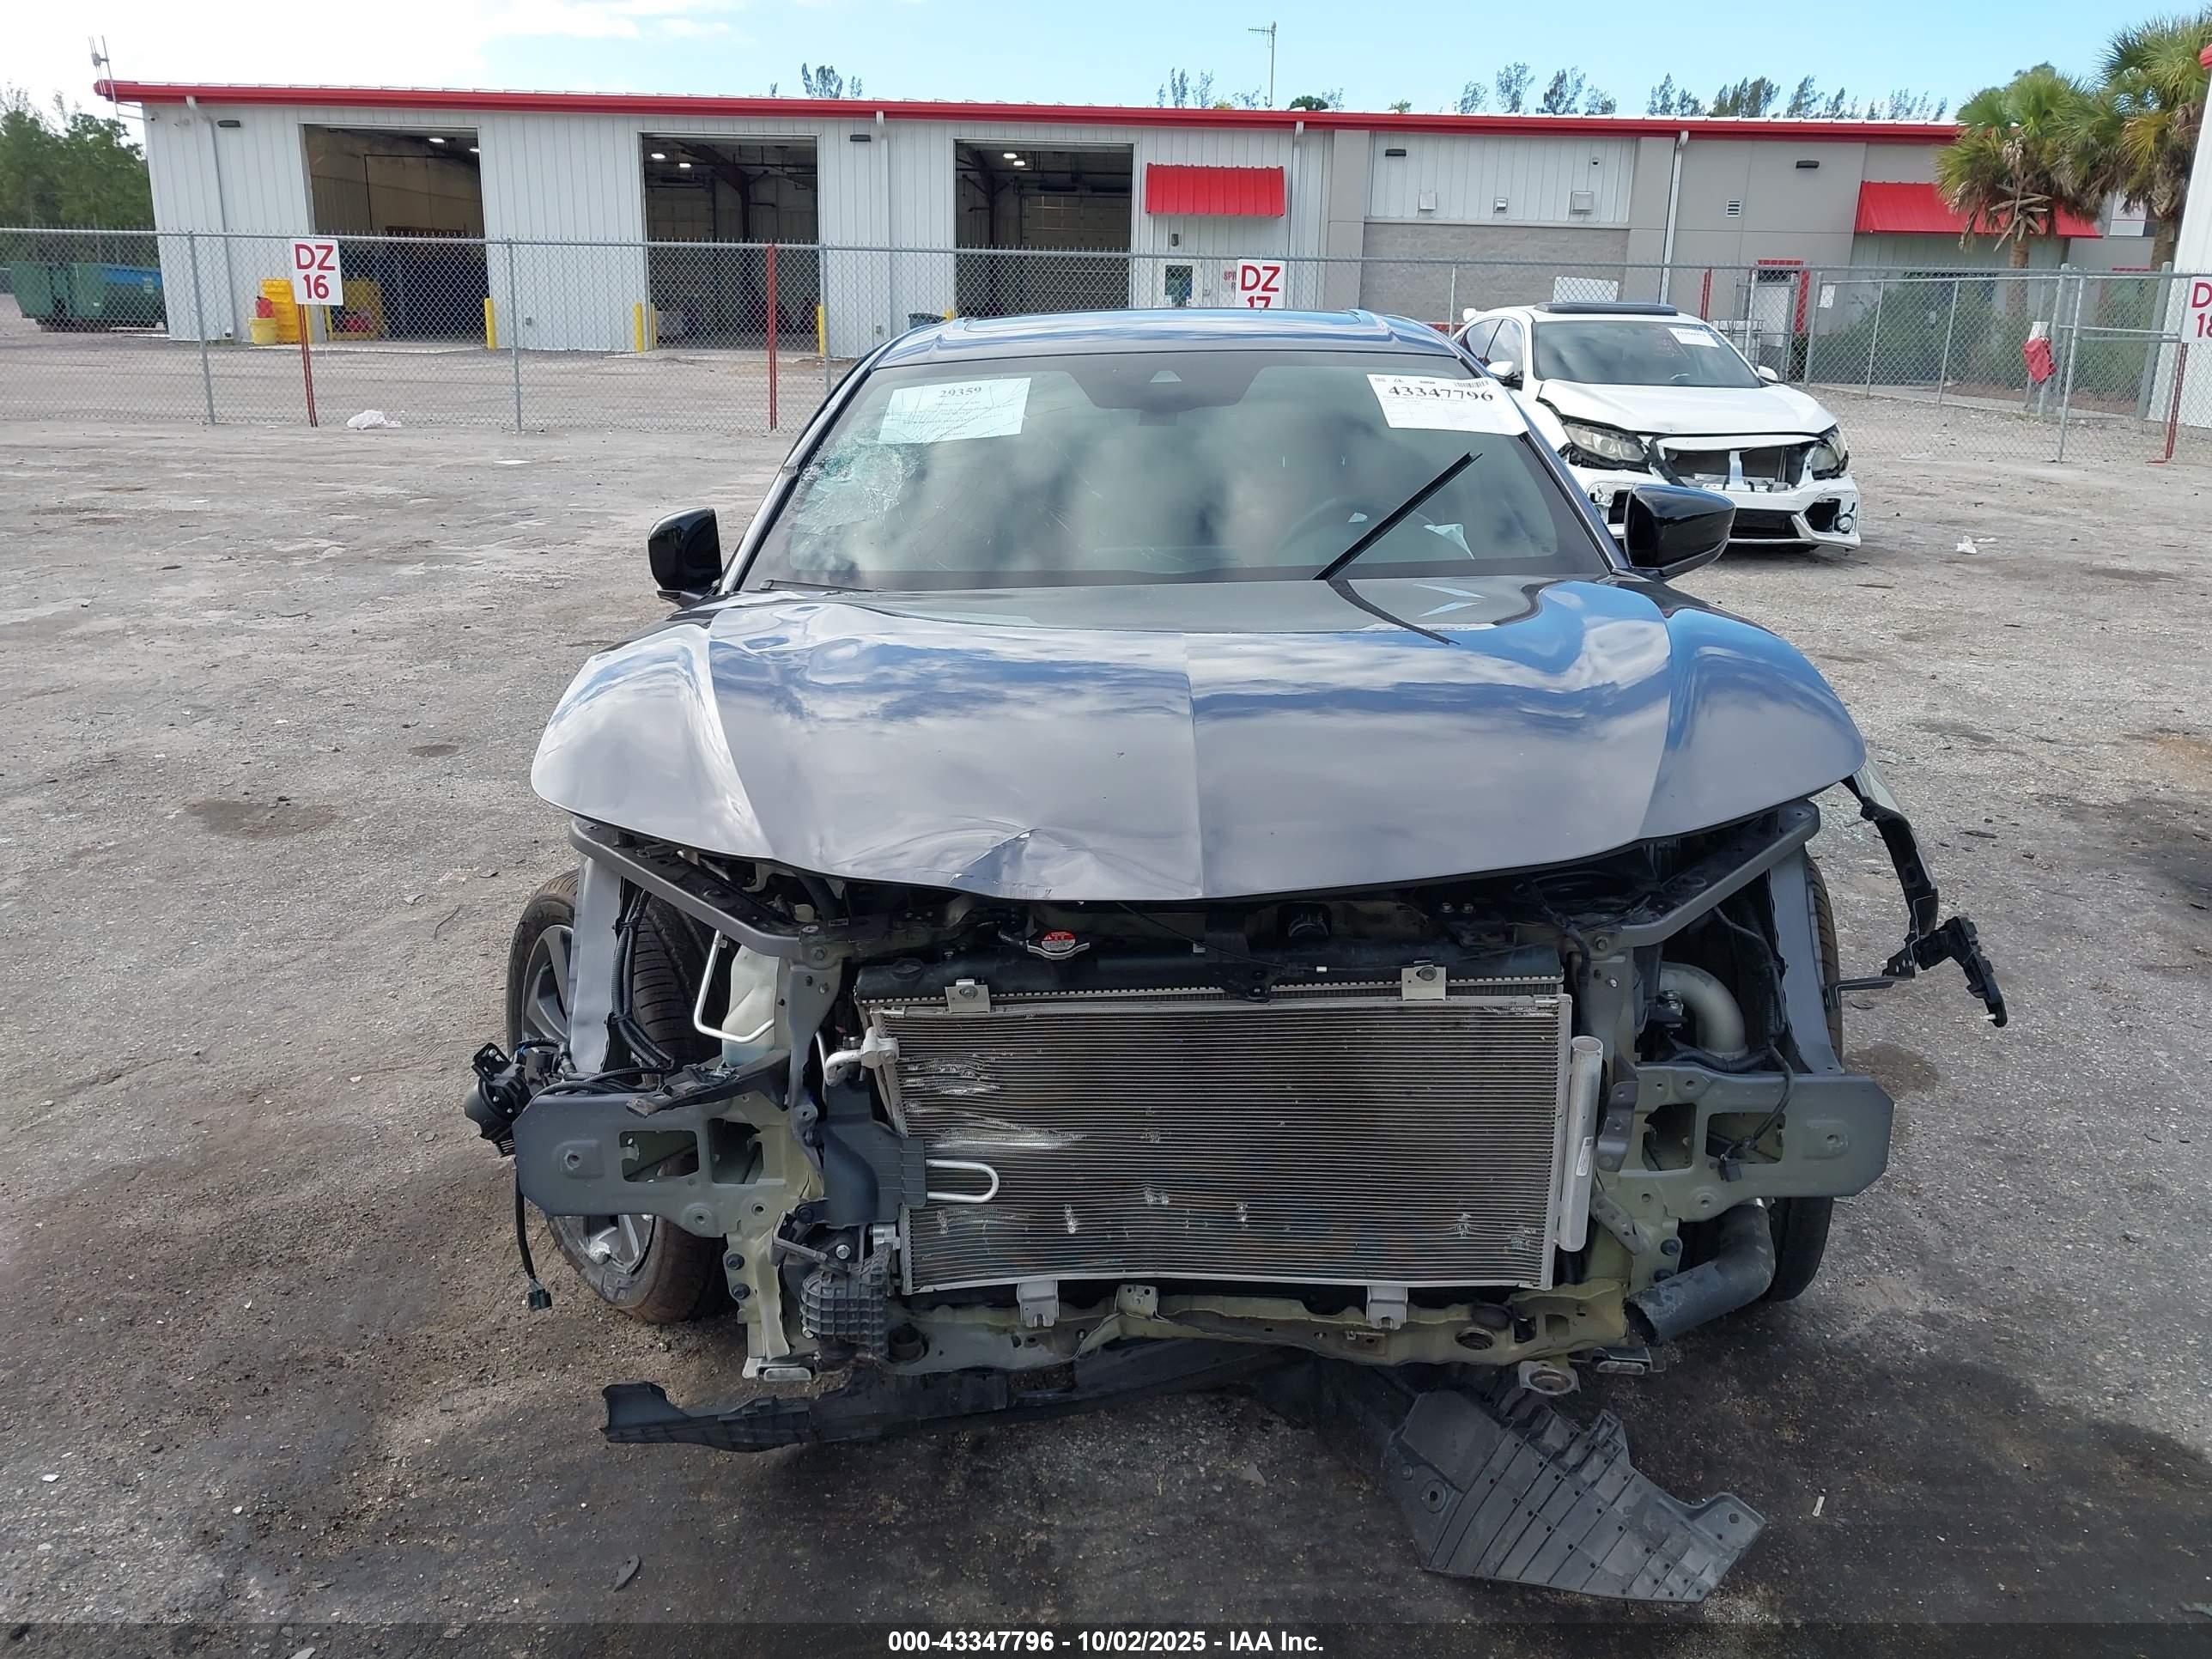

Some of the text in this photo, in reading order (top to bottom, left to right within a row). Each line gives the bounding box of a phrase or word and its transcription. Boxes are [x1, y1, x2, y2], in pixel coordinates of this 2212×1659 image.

[295, 244, 336, 270] DZ
[303, 274, 329, 300] 16
[1241, 264, 1280, 292] DZ
[939, 386, 981, 398] 29359
[1389, 386, 1493, 401] 43347796
